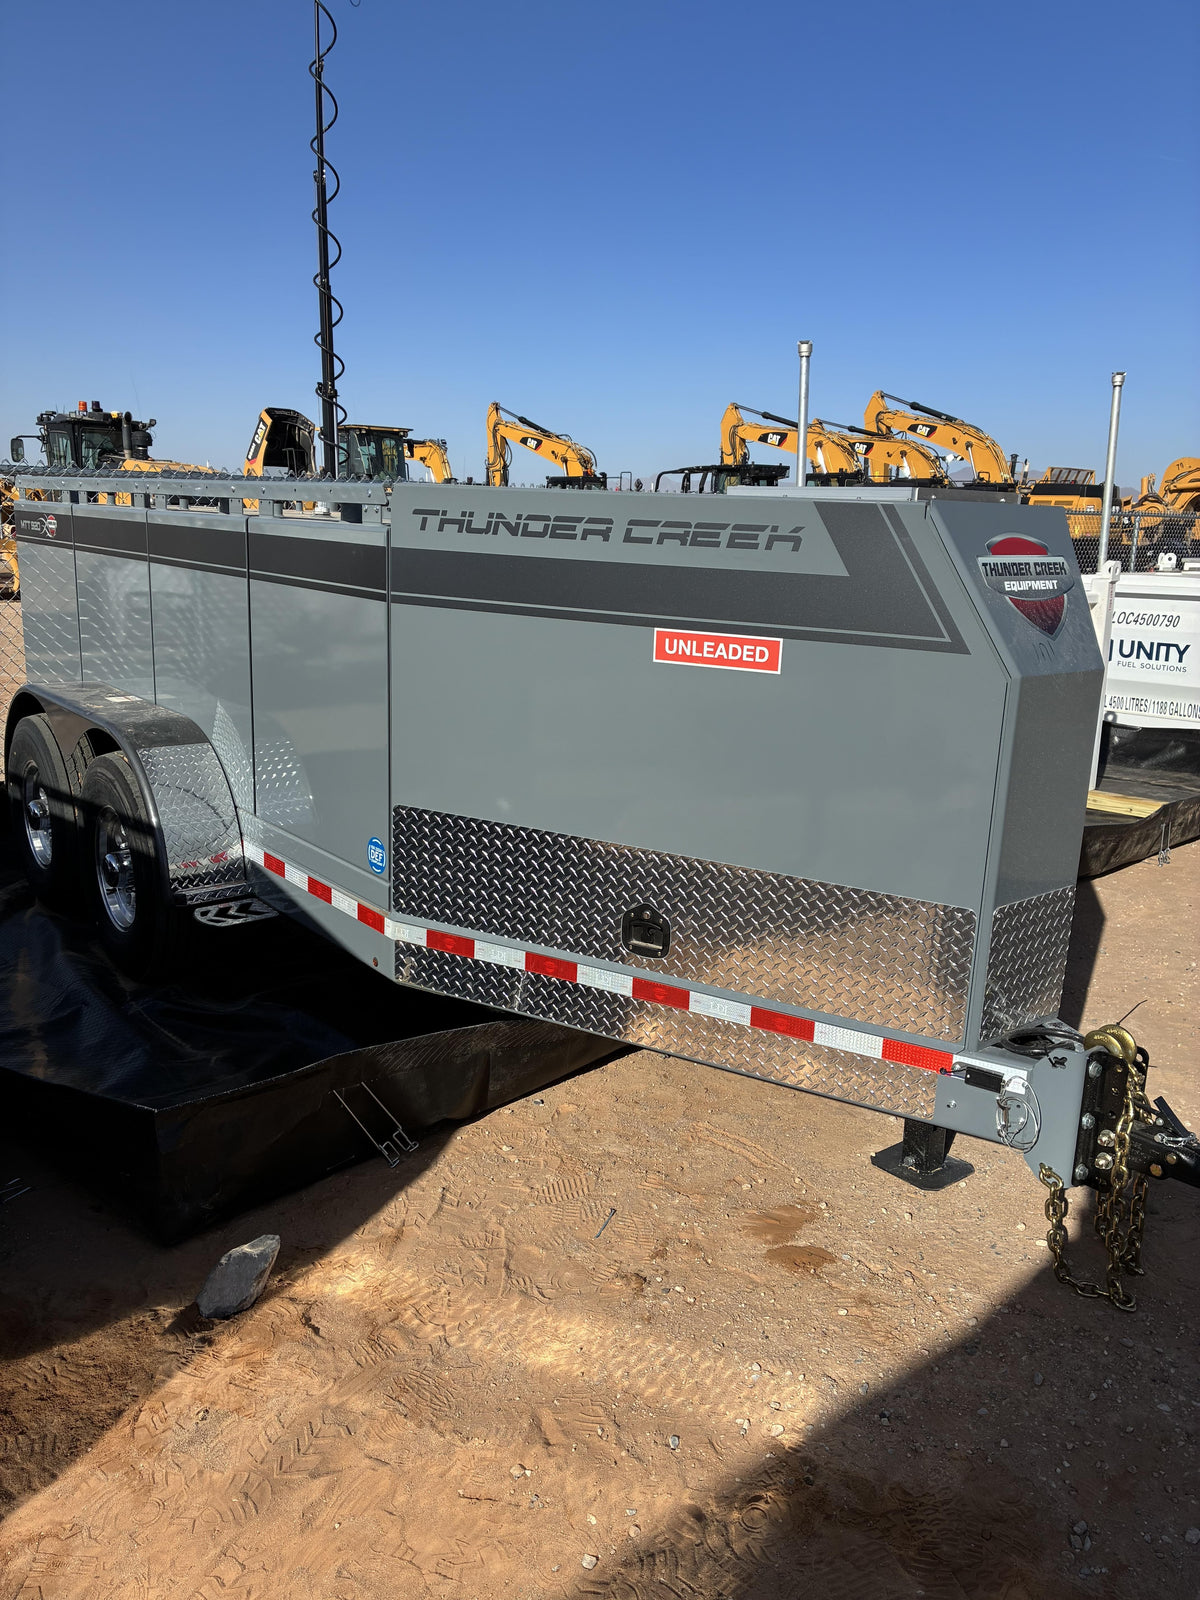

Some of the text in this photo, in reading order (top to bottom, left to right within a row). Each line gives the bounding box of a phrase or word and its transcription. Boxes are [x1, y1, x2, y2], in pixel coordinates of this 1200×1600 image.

[255, 421, 266, 444] CAT
[917, 425, 930, 437] CAT
[527, 438, 537, 449] CAT
[768, 433, 780, 445] CAT
[854, 443, 867, 454] CAT
[412, 508, 806, 552] THUNDER CREEK
[982, 562, 1067, 577] THUNDER CREEK
[1004, 580, 1058, 592] EQUIPMENT
[665, 638, 769, 663] UNLEADED
[1119, 639, 1191, 663] UNITY
[1117, 660, 1187, 673] FUEL SOLUTIONS
[1109, 695, 1124, 710] 4500
[371, 849, 384, 863] DEF
